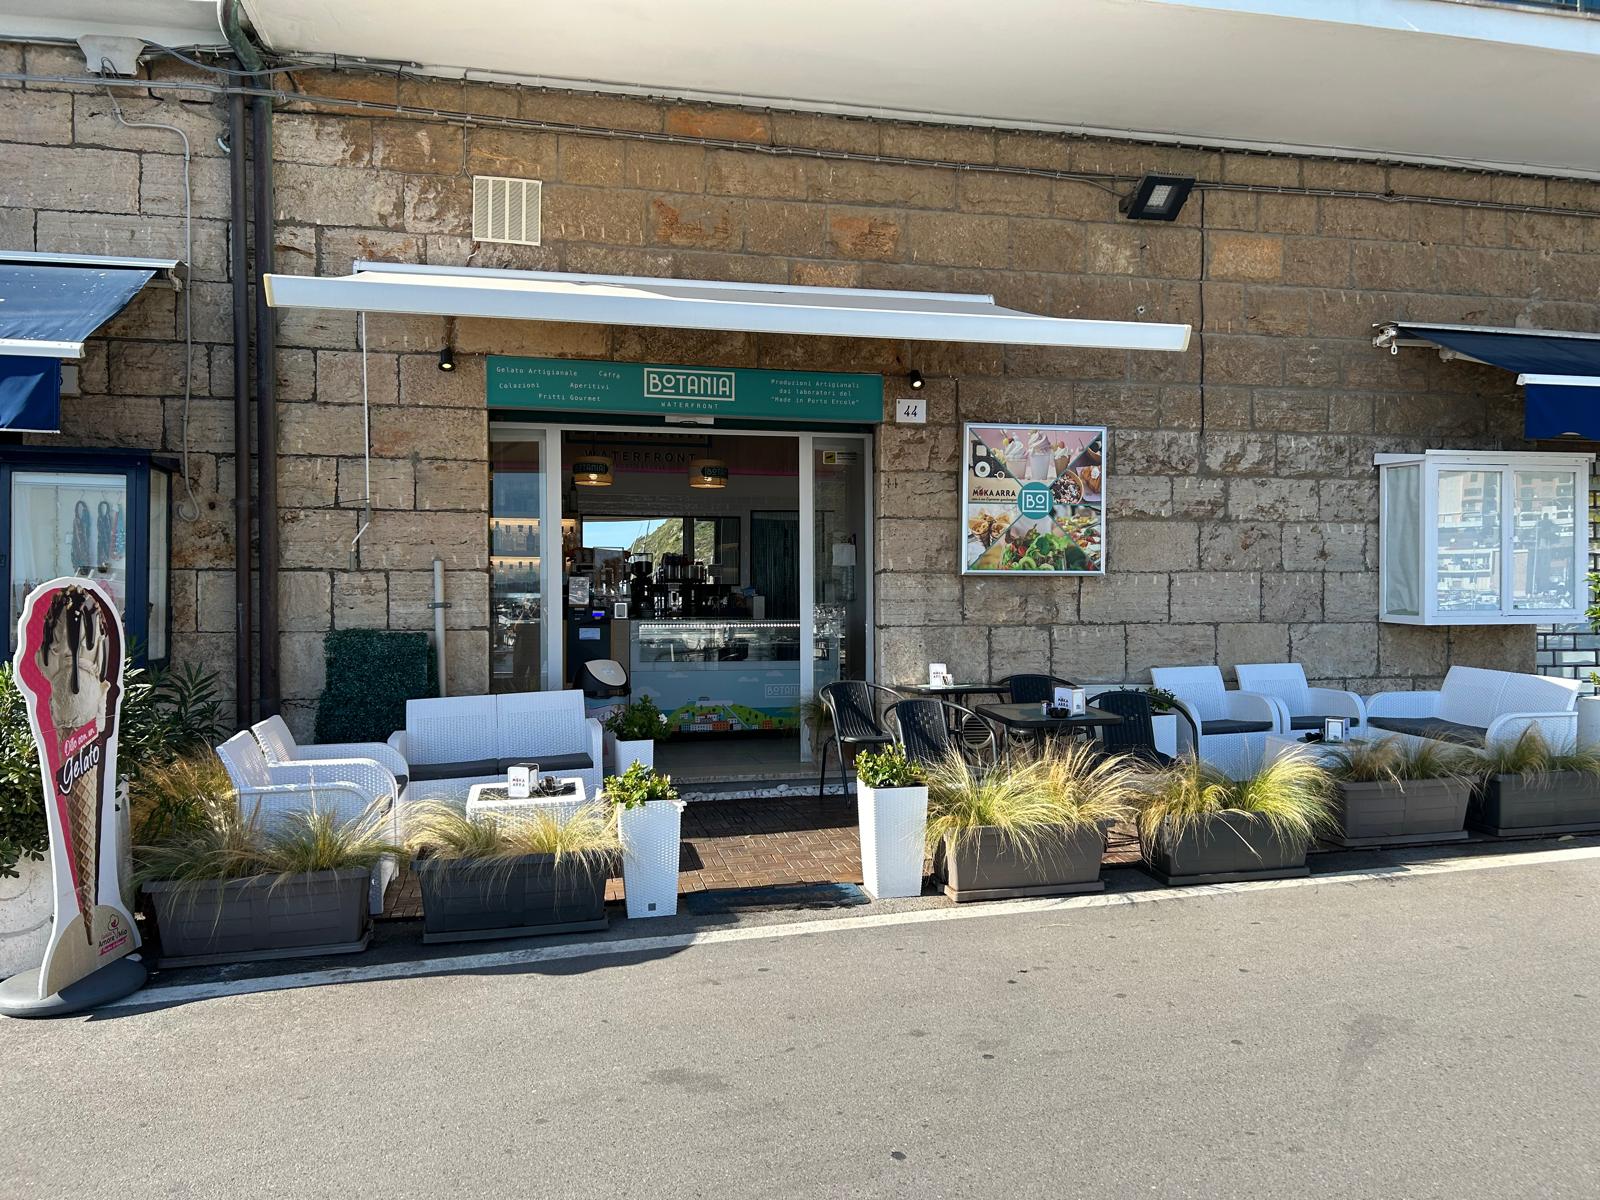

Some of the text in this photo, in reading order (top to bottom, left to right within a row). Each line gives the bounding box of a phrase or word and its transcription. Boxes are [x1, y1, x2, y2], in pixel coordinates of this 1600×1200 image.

[496, 366, 578, 377] Gelato Artigianale
[569, 382, 609, 390] Aperitivi
[649, 373, 730, 396] BOTANIA
[770, 378, 860, 389] Produzioni Artigianali
[796, 388, 836, 396] laboratori
[538, 393, 601, 402] Fritti Gourmet
[807, 397, 828, 405] Porto
[660, 401, 719, 410] WATERFRONT
[903, 405, 918, 417] 44
[767, 686, 800, 696] BOTANI
[60, 744, 99, 794] Gelato
